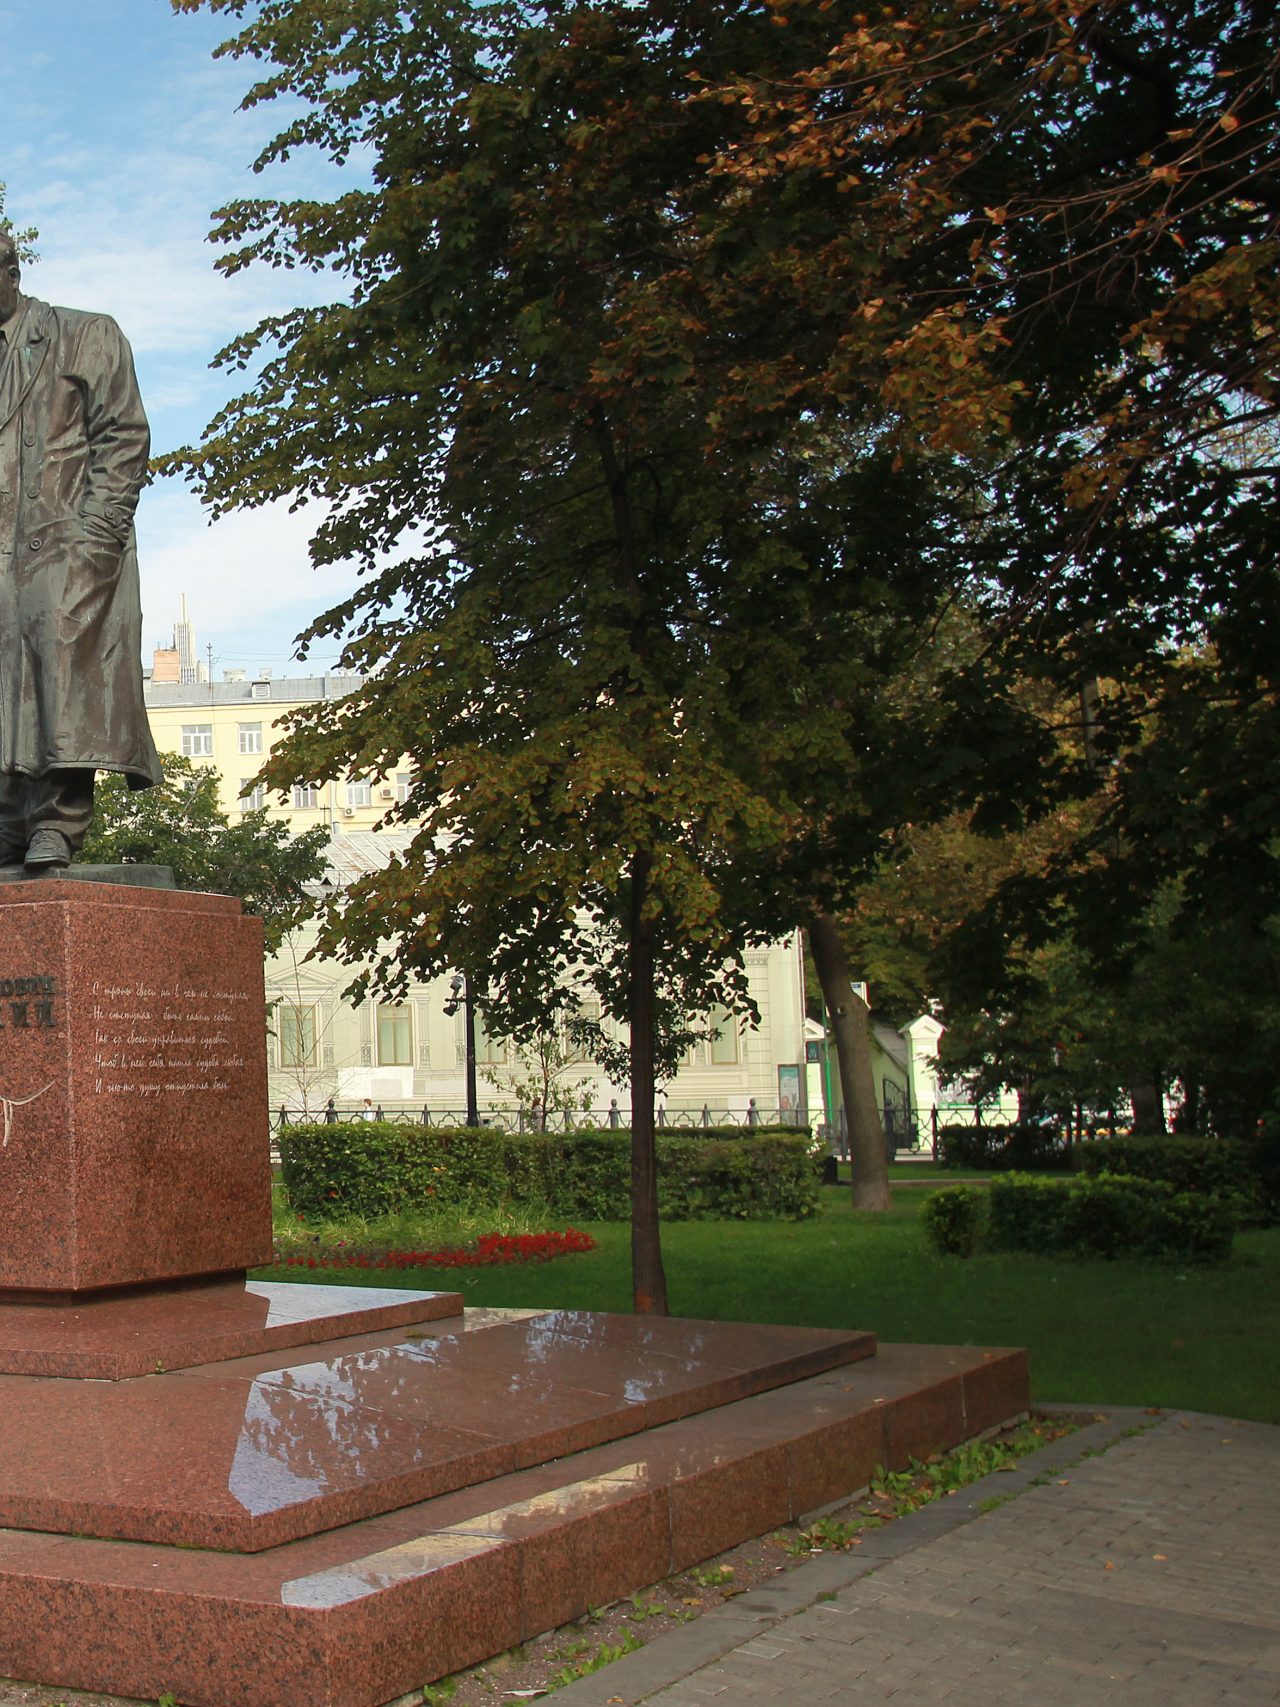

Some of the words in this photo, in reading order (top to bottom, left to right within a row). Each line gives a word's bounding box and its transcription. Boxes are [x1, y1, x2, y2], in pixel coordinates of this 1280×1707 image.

[92, 981, 99, 996] С
[93, 1005, 103, 1020] Не
[121, 1054, 125, 1067] в
[96, 1078, 102, 1093] И
